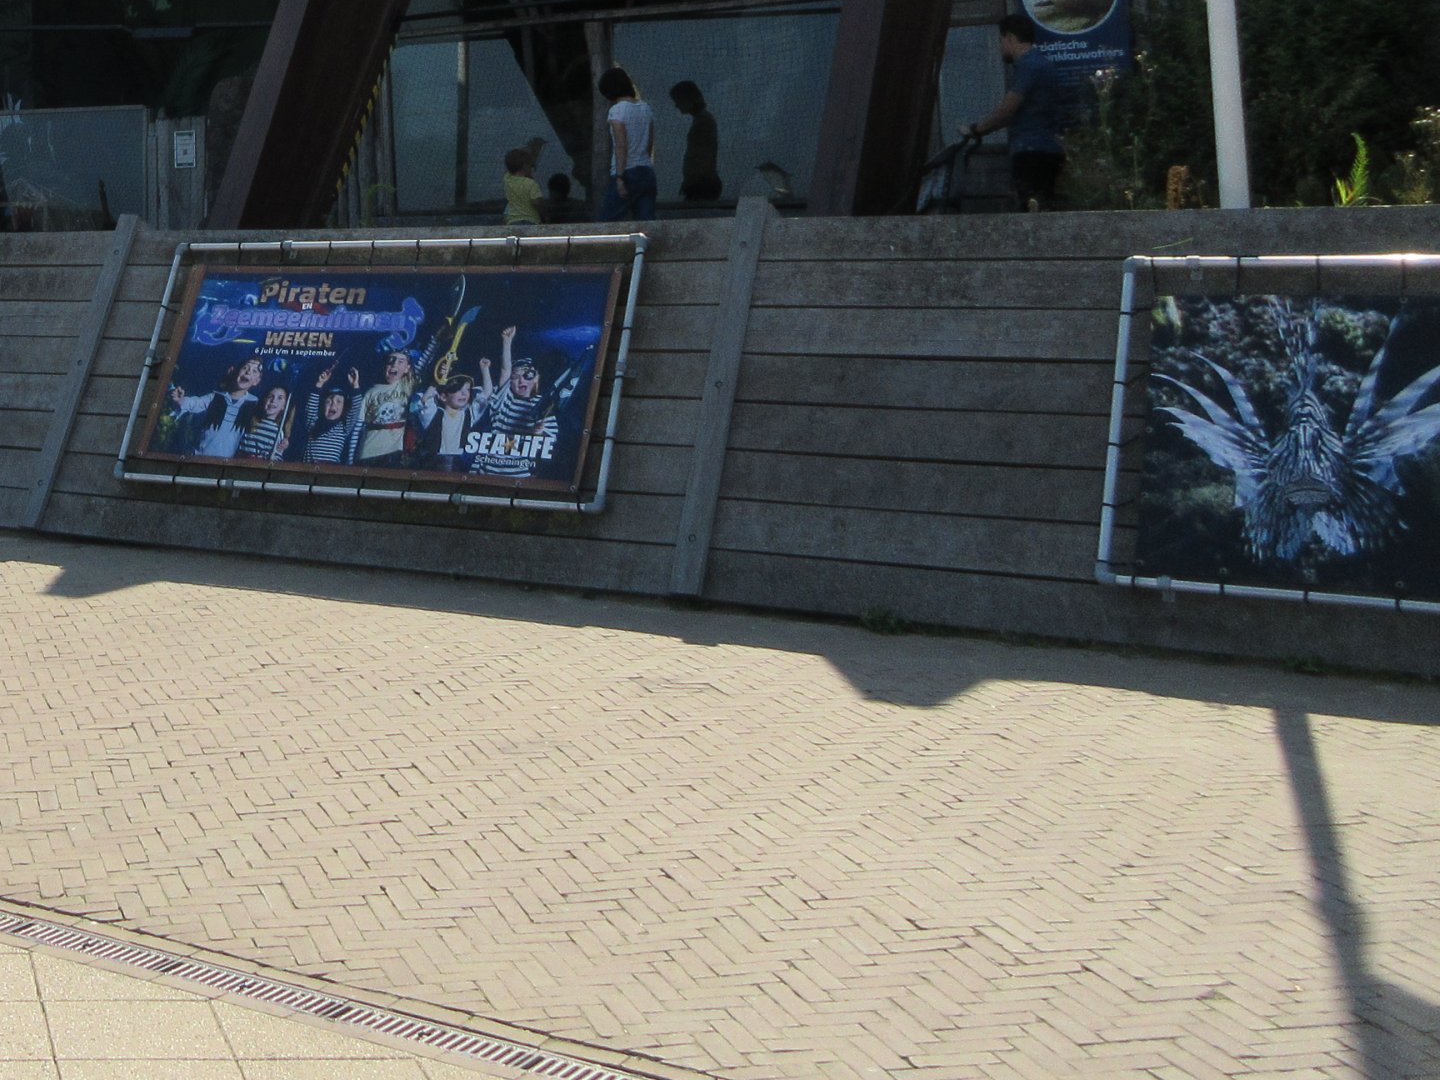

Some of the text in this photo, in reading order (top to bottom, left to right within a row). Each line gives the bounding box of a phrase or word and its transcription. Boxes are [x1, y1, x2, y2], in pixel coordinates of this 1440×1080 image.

[260, 280, 366, 305] Piraten
[301, 302, 314, 311] EN
[210, 304, 407, 329] Zeemeerminnen
[264, 331, 334, 348] WEKEN
[260, 348, 274, 357] juli
[295, 349, 337, 358] september
[465, 431, 505, 455] SEA
[474, 454, 537, 469] Scheveningen
